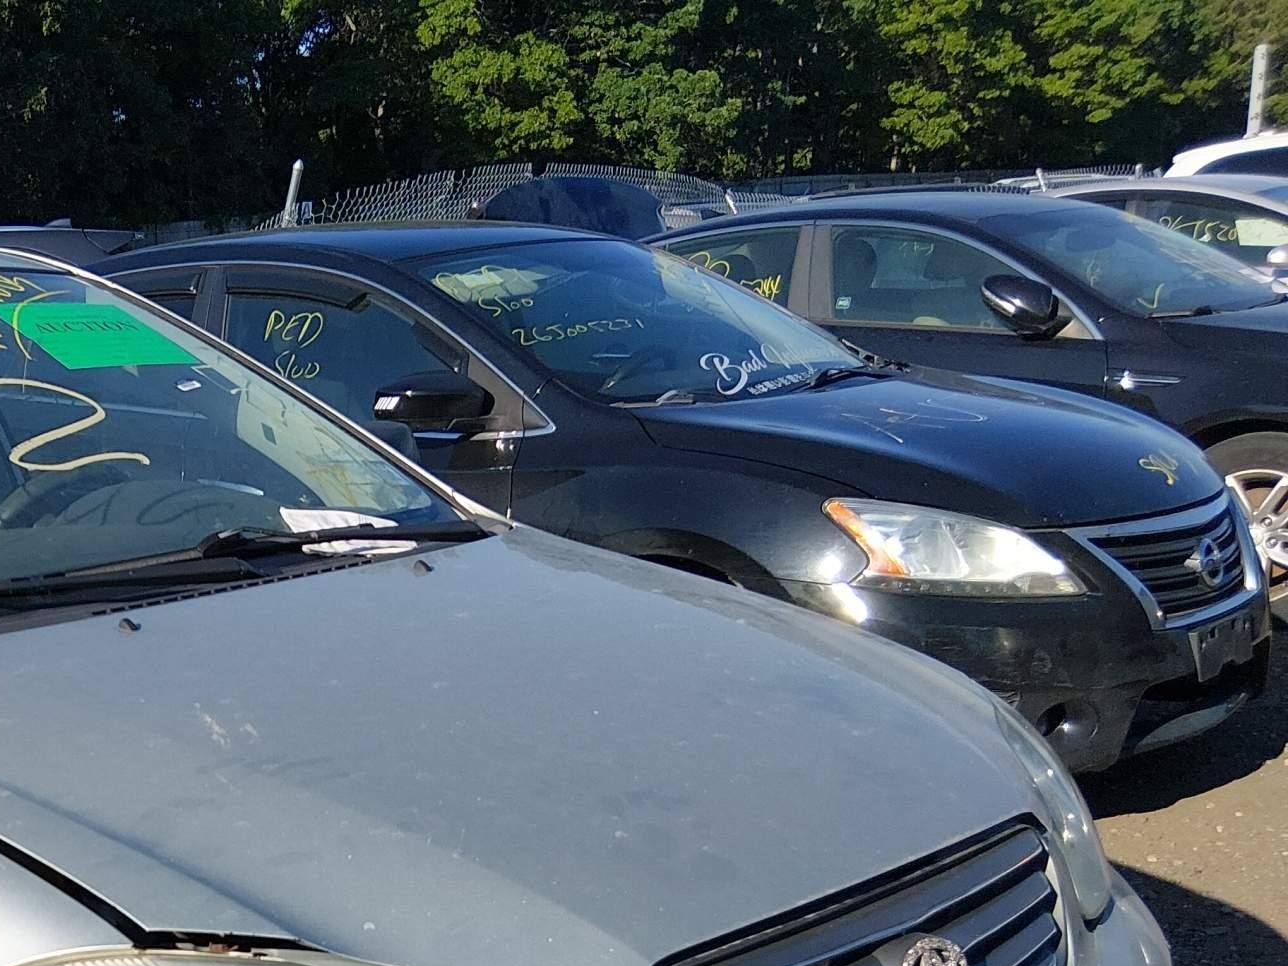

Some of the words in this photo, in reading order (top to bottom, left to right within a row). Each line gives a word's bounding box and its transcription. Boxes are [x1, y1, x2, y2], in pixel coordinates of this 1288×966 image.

[34, 320, 141, 335] AUCTION
[263, 309, 324, 349] PED
[699, 348, 769, 396] Bad
